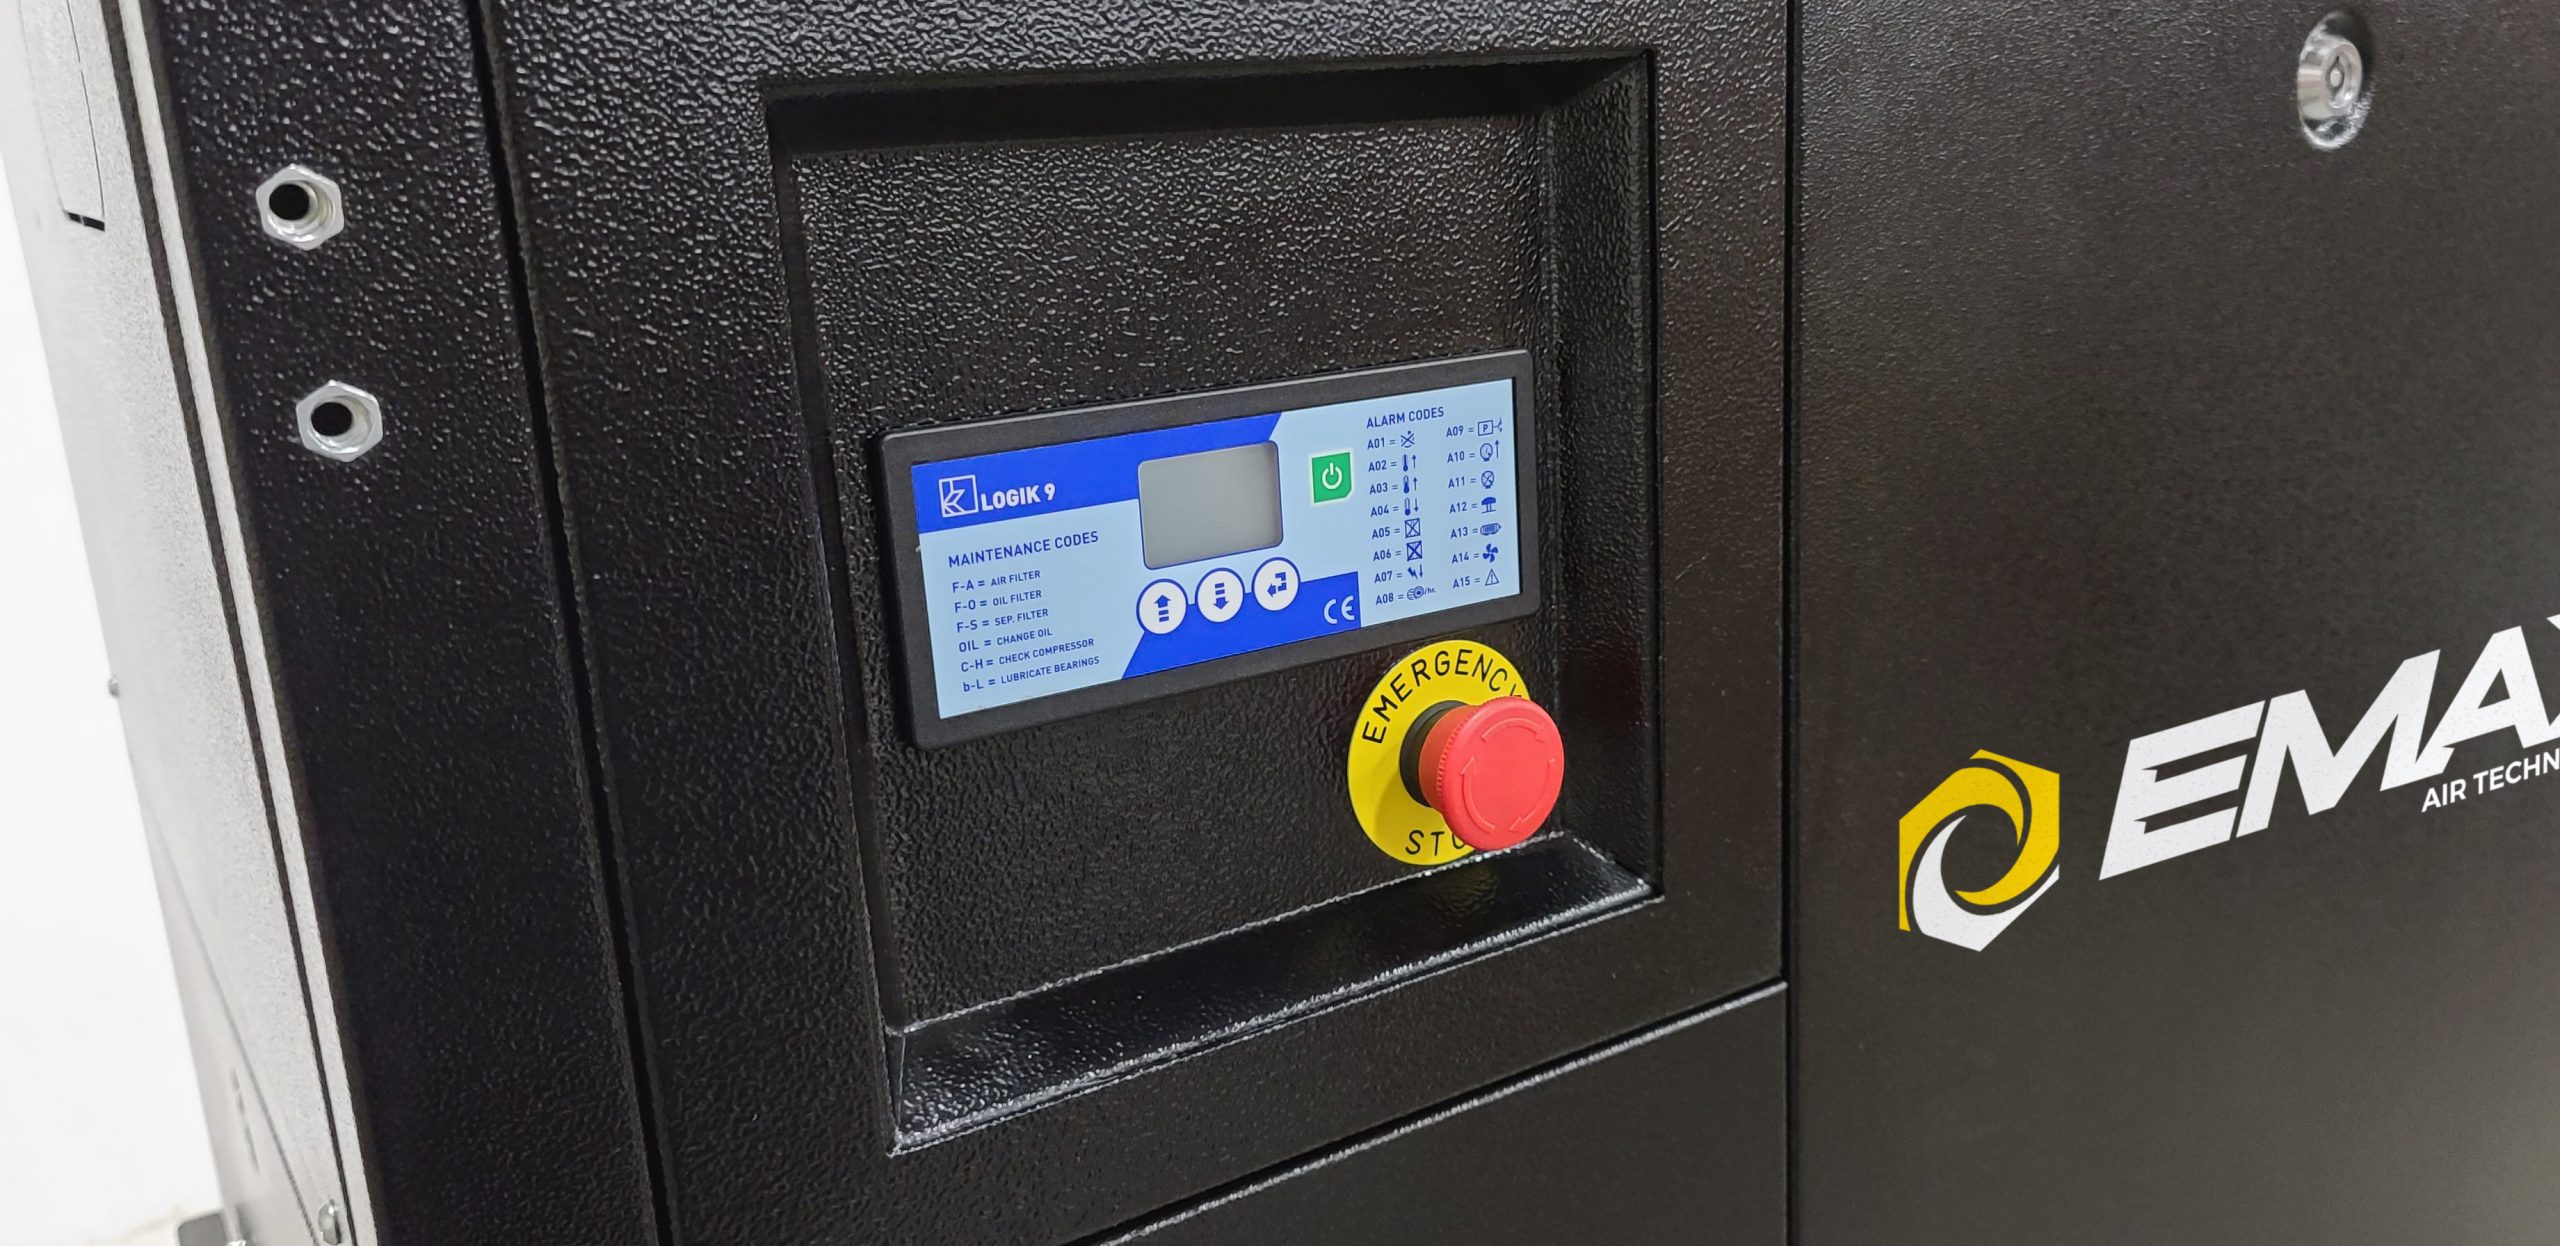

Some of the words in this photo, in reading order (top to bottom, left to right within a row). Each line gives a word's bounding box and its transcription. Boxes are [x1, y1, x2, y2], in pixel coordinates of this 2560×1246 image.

[1366, 413, 1406, 429] ALARM
[1408, 407, 1445, 422] CODES
[1445, 426, 1464, 438] A09
[1367, 438, 1385, 450] A01
[1447, 451, 1465, 463] A10
[1368, 460, 1387, 473] A02
[1369, 483, 1388, 495] A03
[1447, 476, 1465, 489] A11
[980, 486, 1041, 512] LOGIK
[1044, 483, 1056, 501] 9
[1370, 505, 1390, 518] A04
[1449, 502, 1468, 514] A12
[1371, 527, 1391, 540] A05
[1450, 527, 1469, 540] A13
[948, 539, 1051, 568] MAINTENANCE
[1054, 531, 1099, 549] CODES
[1372, 549, 1392, 562] A06
[1451, 552, 1470, 564] A14
[952, 580, 975, 593] F-A
[991, 577, 1006, 586] AIR
[1008, 570, 1041, 584] FILTER
[1374, 571, 1393, 584] A07
[1452, 576, 1471, 589] A15
[954, 600, 976, 614] F-O
[992, 596, 1009, 607] OIL
[1010, 590, 1042, 603] FILTER
[1375, 593, 1394, 606] A08
[956, 620, 978, 633] F-S
[994, 615, 1016, 627] SEP.
[1016, 609, 1049, 622] FILTER
[958, 640, 980, 653] OIL
[996, 631, 1036, 646] CHANGE
[1037, 628, 1053, 638] OIL
[960, 659, 984, 673] C-H
[998, 651, 1031, 665] CHECK
[1032, 638, 1095, 658] COMPRESSOR
[962, 679, 984, 693] b-L
[1000, 666, 1052, 684] LUBRICATE
[1053, 656, 1100, 673] BEARINGS
[2099, 613, 2560, 880] EMA
[2420, 778, 2467, 813] AIR
